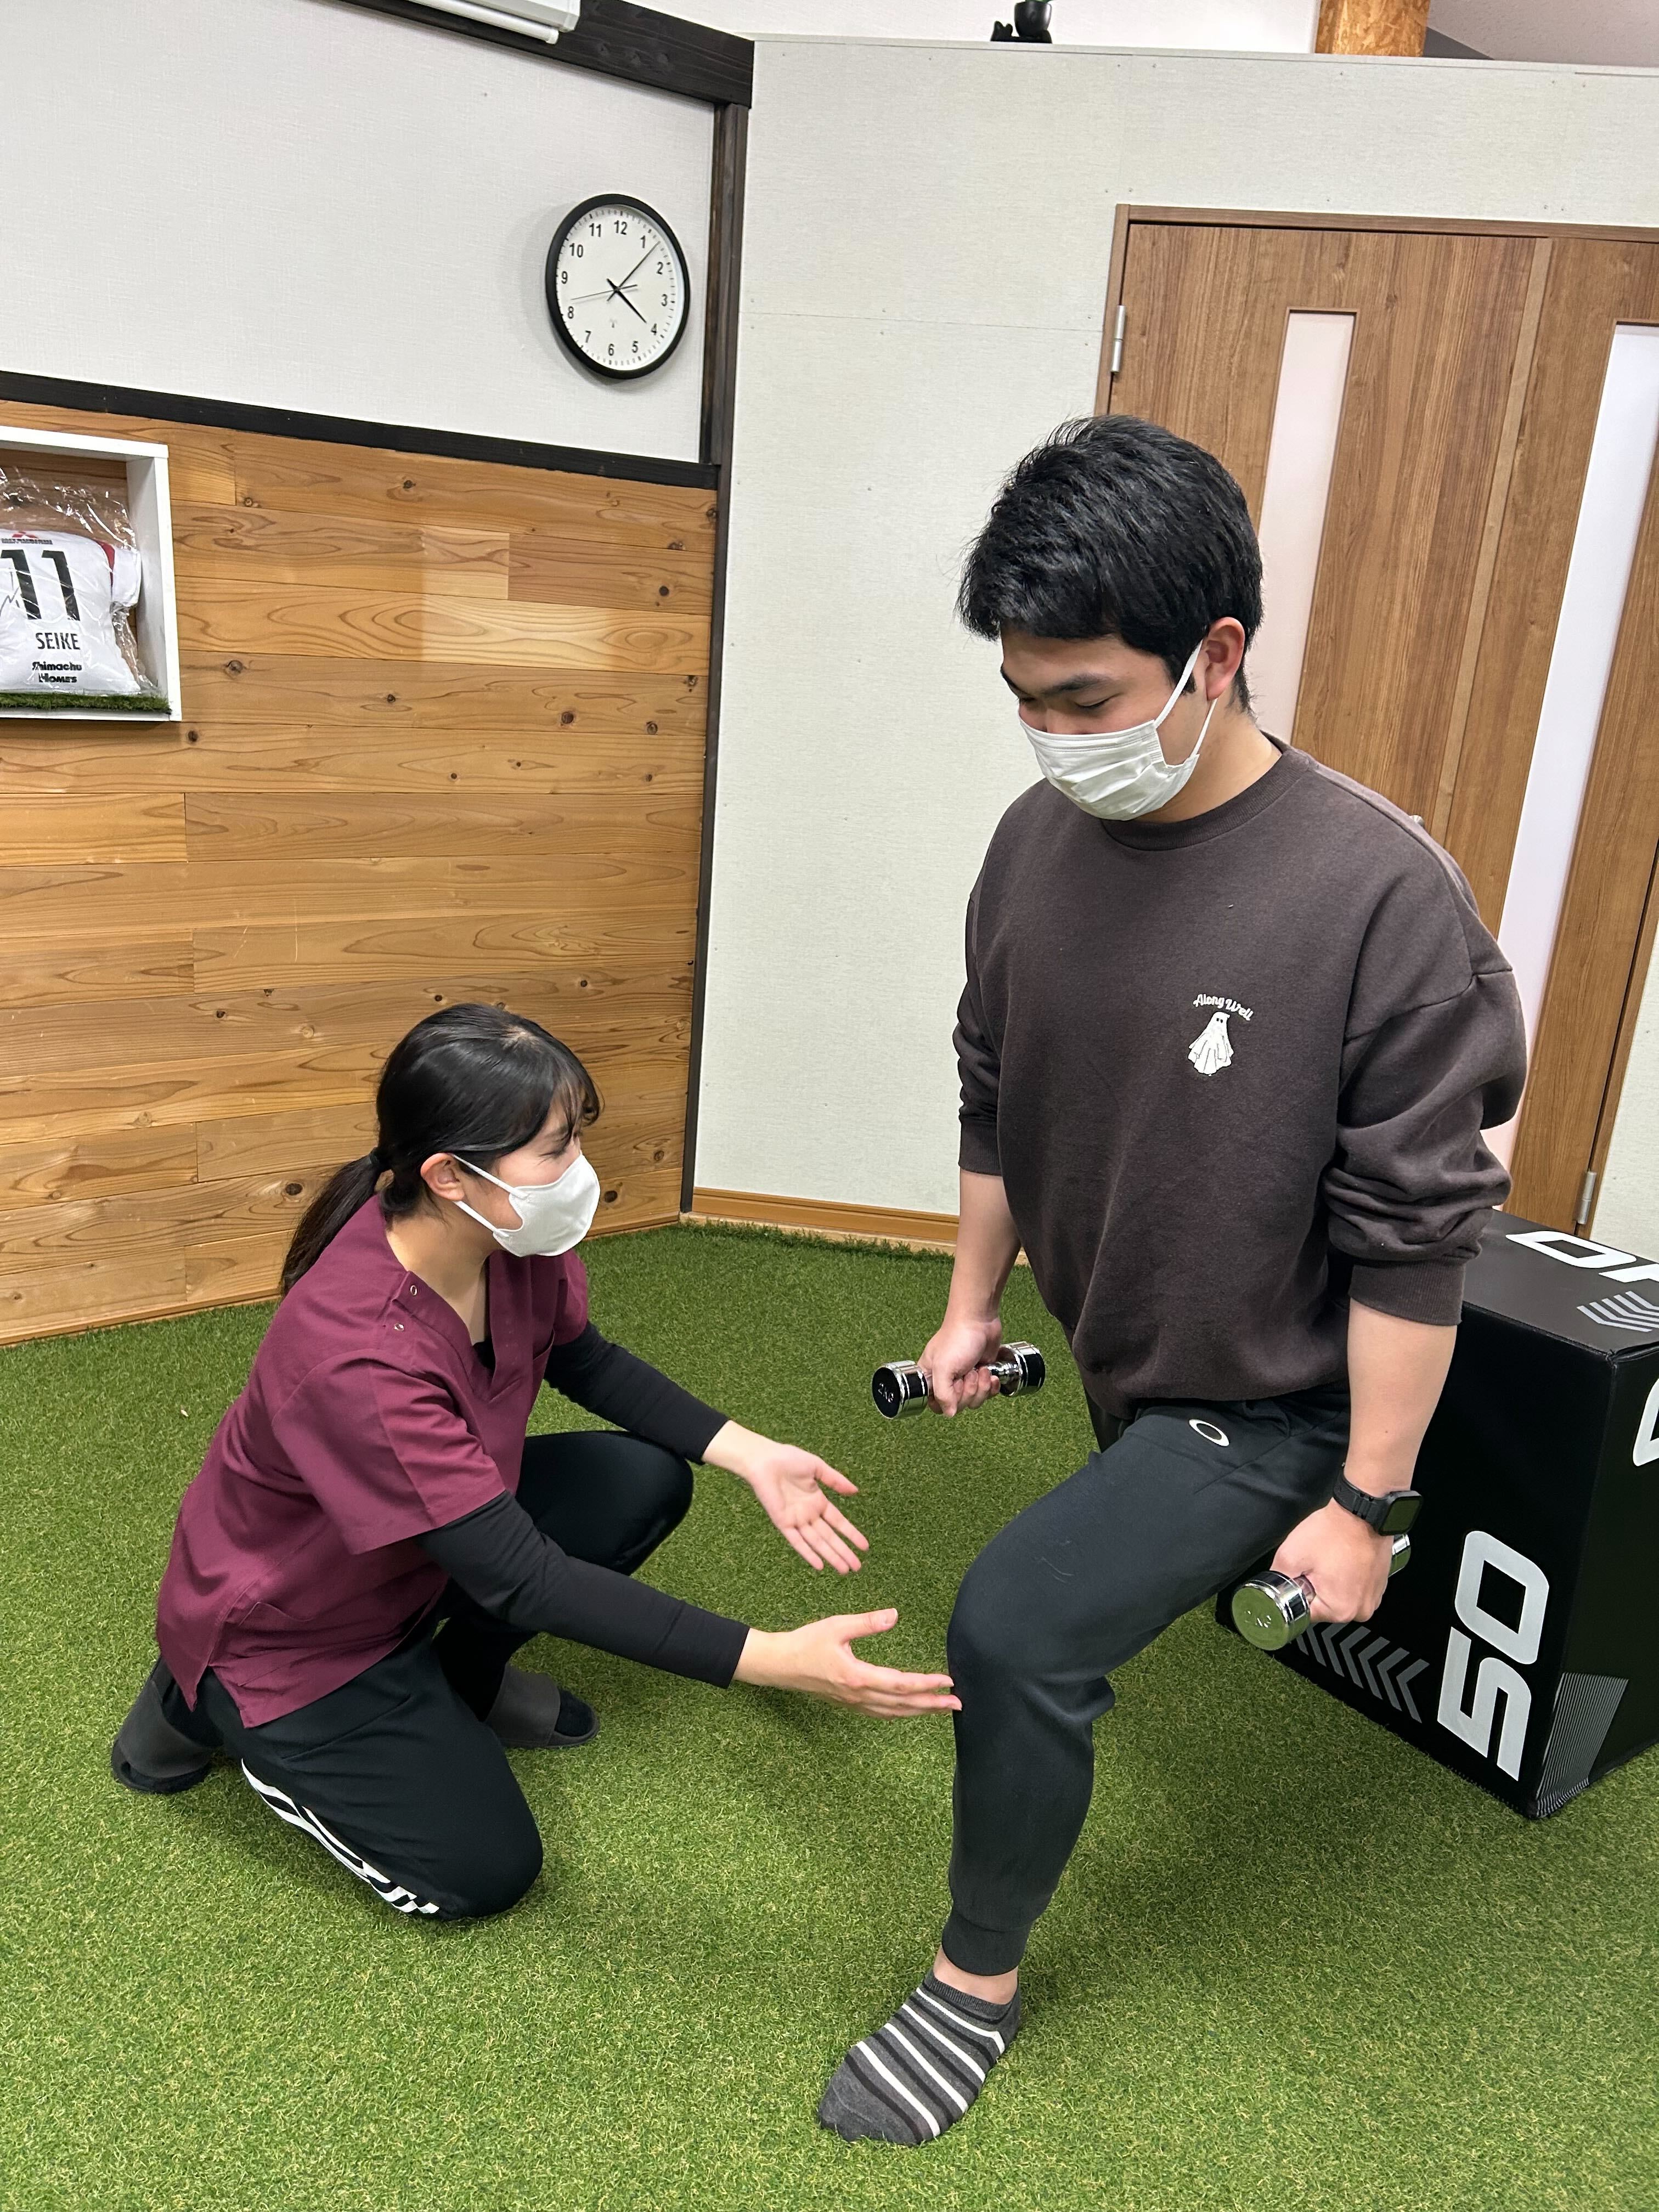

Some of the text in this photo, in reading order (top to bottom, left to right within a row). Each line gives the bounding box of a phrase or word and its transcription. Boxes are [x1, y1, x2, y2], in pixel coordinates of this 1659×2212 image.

[589, 223, 602, 237] 11
[614, 220, 628, 235] 12
[640, 235, 646, 249] 1
[569, 242, 584, 258] 10
[656, 262, 663, 274] 2
[561, 271, 568, 284] 9
[661, 294, 668, 307] 3
[567, 306, 574, 319] 8
[651, 323, 657, 336] 4
[585, 330, 591, 343] 7
[608, 343, 614, 356] 6
[631, 341, 639, 353] 5
[1, 549, 81, 621] 11
[36, 632, 80, 650] SEIKE
[32, 661, 82, 671] Shimachu
[1193, 994, 1254, 1021] Along Well
[1437, 1530, 1549, 1781] 50
